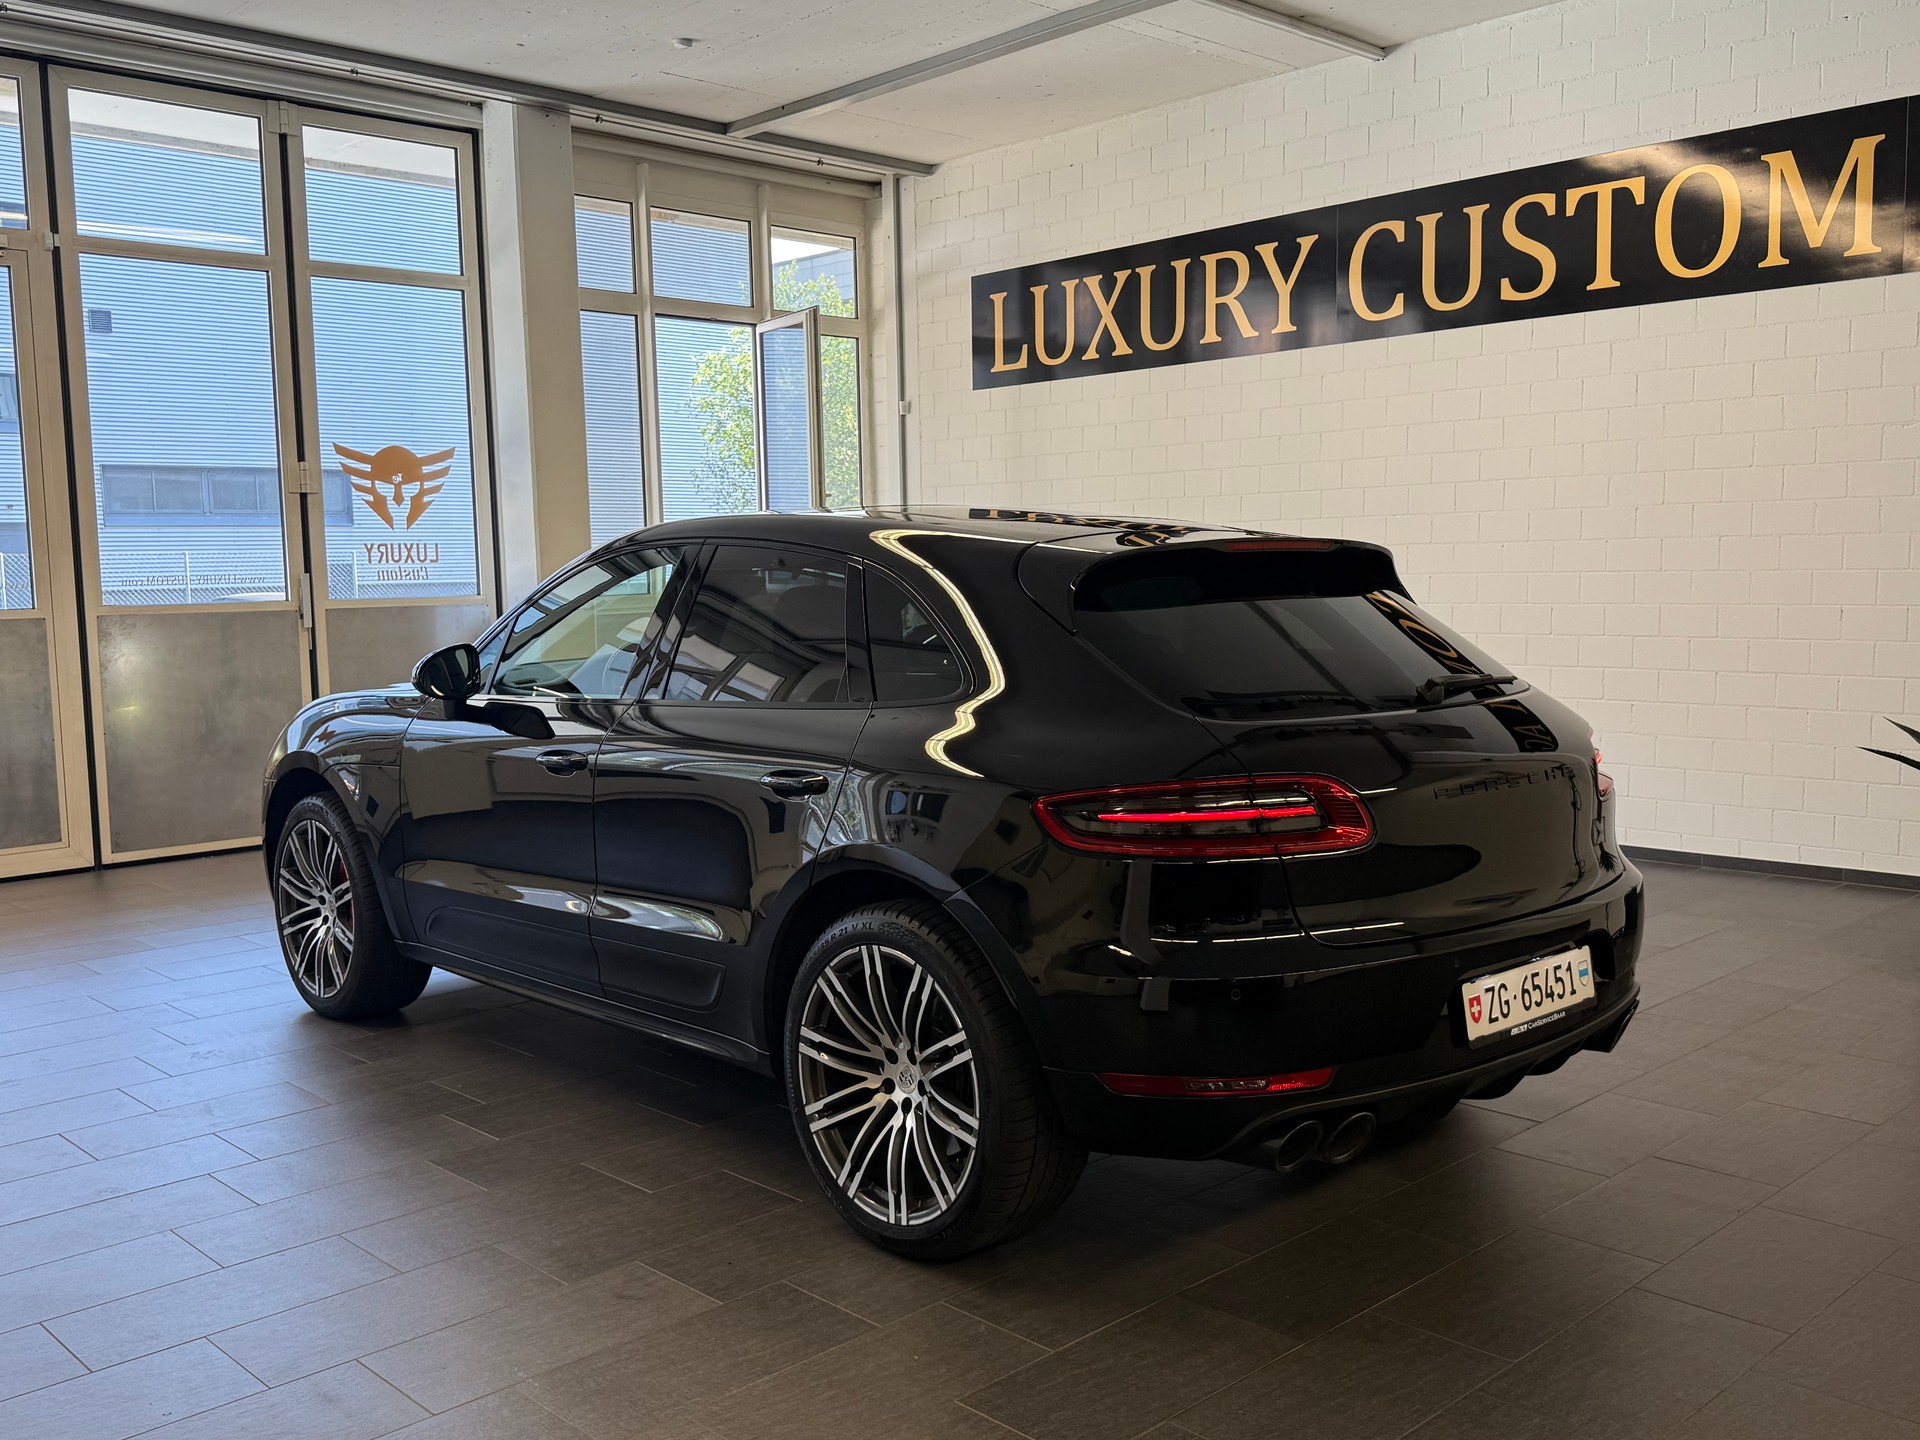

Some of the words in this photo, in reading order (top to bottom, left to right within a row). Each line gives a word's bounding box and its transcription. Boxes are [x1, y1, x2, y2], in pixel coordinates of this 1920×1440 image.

[989, 234, 1318, 374] LUXURY
[1348, 133, 1886, 321] CUSTOM
[838, 926, 848, 937] 21
[861, 921, 874, 931] XL
